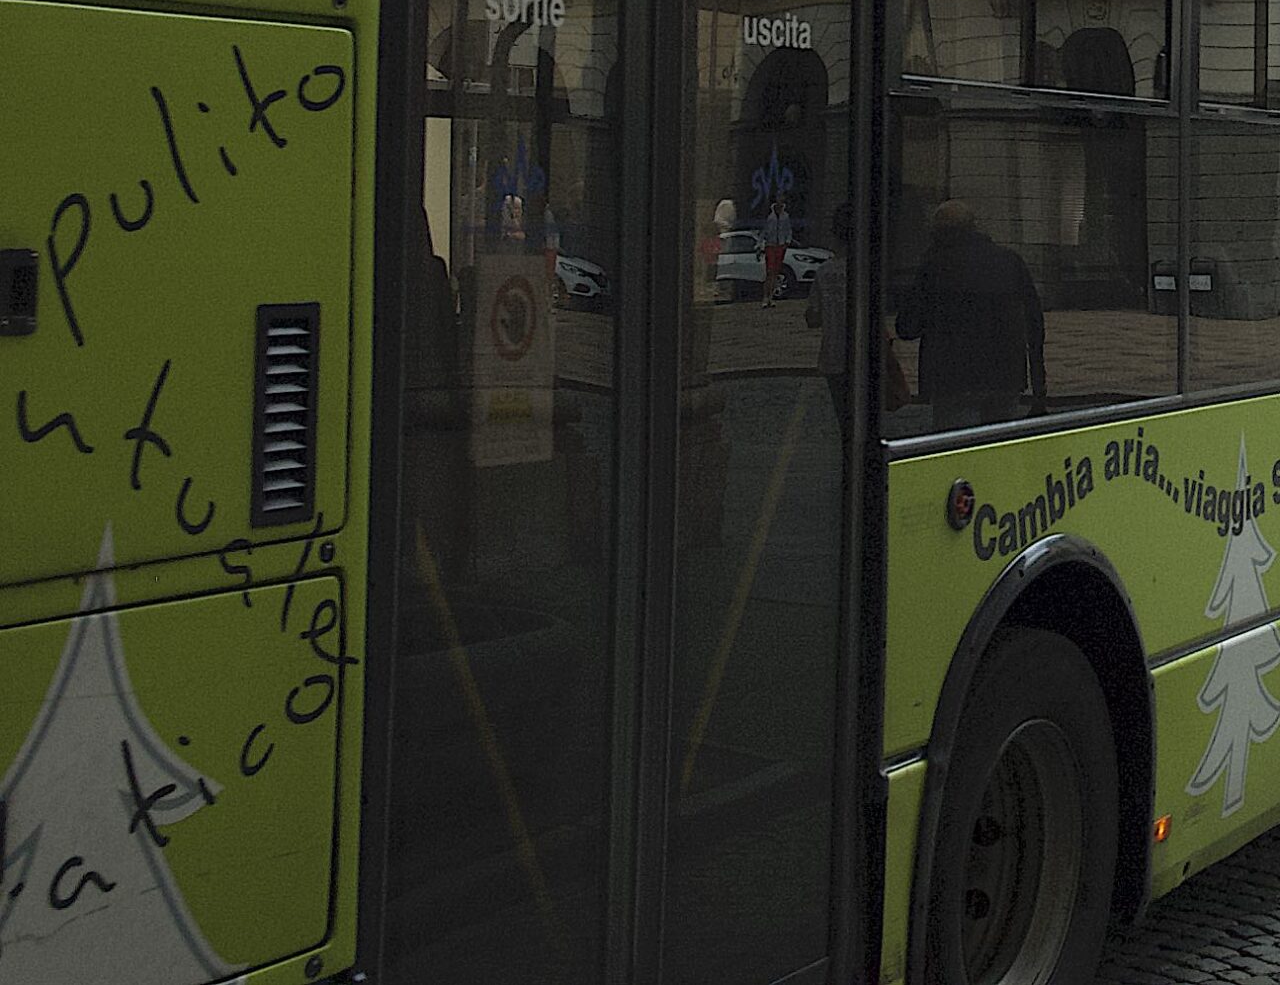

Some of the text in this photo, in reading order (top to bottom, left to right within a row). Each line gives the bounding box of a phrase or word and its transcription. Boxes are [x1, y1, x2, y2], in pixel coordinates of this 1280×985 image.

[743, 13, 812, 50] uscita
[48, 45, 346, 347] pulito
[973, 455, 1094, 561] Cambia
